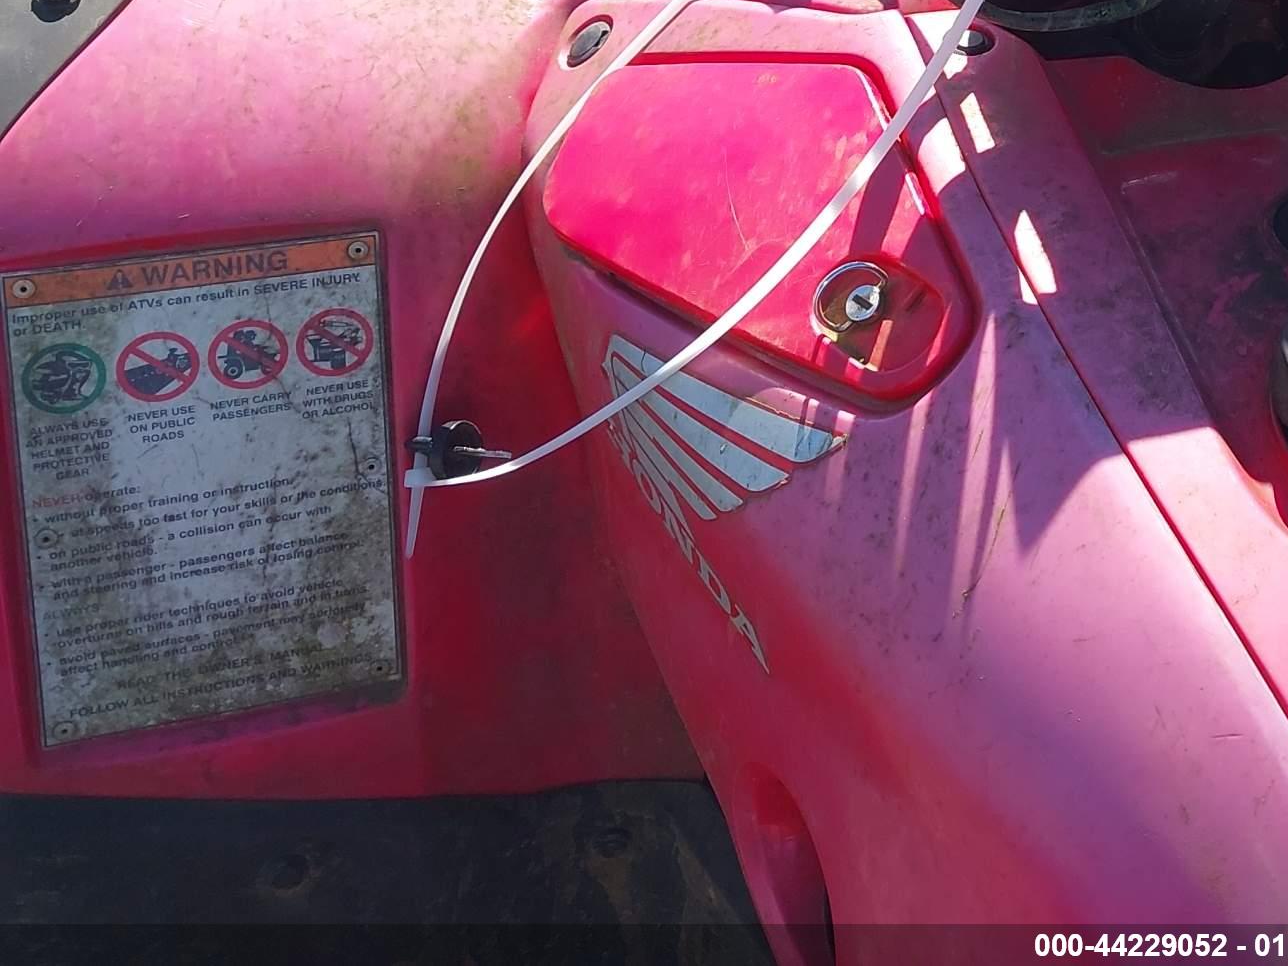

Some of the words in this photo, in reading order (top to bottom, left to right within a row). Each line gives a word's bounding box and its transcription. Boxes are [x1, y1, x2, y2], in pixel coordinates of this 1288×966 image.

[141, 251, 288, 286] WARNING
[12, 308, 77, 325] Improper
[81, 305, 105, 315] use
[111, 303, 123, 313] of
[128, 298, 163, 311] ATVs
[167, 295, 191, 306] can
[196, 289, 235, 303] result
[238, 287, 249, 298] in
[253, 278, 309, 294] SEVERE
[14, 327, 29, 337] or
[32, 320, 86, 334] DEATH.
[306, 382, 344, 396] NEVER
[347, 379, 369, 390] USE
[209, 397, 249, 411] NEVER
[252, 391, 292, 404] CARRY
[302, 396, 332, 409] WITH
[335, 390, 374, 404] DRUGS
[127, 407, 168, 422] NEVER
[171, 404, 197, 415] USE
[212, 402, 292, 422] PASSENGERS
[302, 409, 319, 420] OR
[321, 402, 375, 417] ALCOHOL
[30, 421, 80, 435] ALWAYS
[82, 417, 110, 428] USE
[130, 424, 149, 434] ON
[151, 416, 196, 431] PUBLIC
[26, 438, 45, 448] AN
[47, 429, 113, 446] APPROVED
[142, 430, 185, 443] ROADS
[31, 444, 81, 460] HELMET
[85, 441, 110, 453] AND
[33, 453, 110, 471] PROTECTIVE
[55, 468, 90, 481] GEAR
[32, 494, 81, 508] NEVER
[44, 509, 95, 523] without
[100, 501, 145, 517] proper
[147, 491, 199, 509] training
[202, 489, 218, 499] or
[71, 527, 84, 537] at
[88, 519, 135, 536] speeds
[138, 516, 160, 531] too
[164, 512, 188, 523] fast
[190, 507, 208, 519] for
[212, 504, 240, 518] your
[244, 496, 277, 509] skills
[280, 494, 294, 504] or
[297, 491, 316, 502] the
[319, 480, 386, 497] conditions.
[49, 549, 66, 559] on
[71, 542, 112, 557] public
[116, 536, 155, 549] roads
[167, 533, 176, 541] a
[179, 520, 234, 538] collision
[238, 516, 262, 529] can
[265, 511, 302, 524] occur
[305, 505, 332, 517] with
[606, 418, 770, 674] HONDA
[51, 556, 102, 571] another
[52, 577, 80, 589] with
[97, 563, 166, 583] passenger
[179, 547, 255, 570] passengers
[259, 541, 296, 555] affect
[300, 533, 351, 548] balance
[53, 588, 79, 601] and
[83, 580, 138, 598] steering
[141, 574, 166, 586] and
[169, 564, 226, 581] increase
[229, 557, 254, 571] risk
[257, 555, 270, 566] of
[273, 547, 313, 564] losing
[85, 616, 129, 634] proper
[168, 597, 240, 617] techniques
[244, 592, 257, 603] to
[260, 585, 295, 601] avoid
[299, 579, 343, 593] vehicle
[58, 630, 120, 649] overturns
[126, 626, 142, 636] on
[147, 619, 174, 632] hills
[178, 614, 201, 627] and
[206, 607, 244, 624] rough
[247, 599, 289, 614] terrain
[293, 595, 317, 606] and
[319, 590, 332, 600] in
[59, 651, 96, 665] avoid
[144, 633, 200, 649] surfaces
[213, 618, 275, 640] pavement
[60, 662, 98, 676] affect
[102, 651, 160, 670] handling
[164, 645, 187, 657] and
[69, 698, 129, 718] FOLLOW
[133, 694, 160, 706] ALL
[162, 674, 265, 700] INSTRUCTIONS
[269, 667, 297, 680] AND
